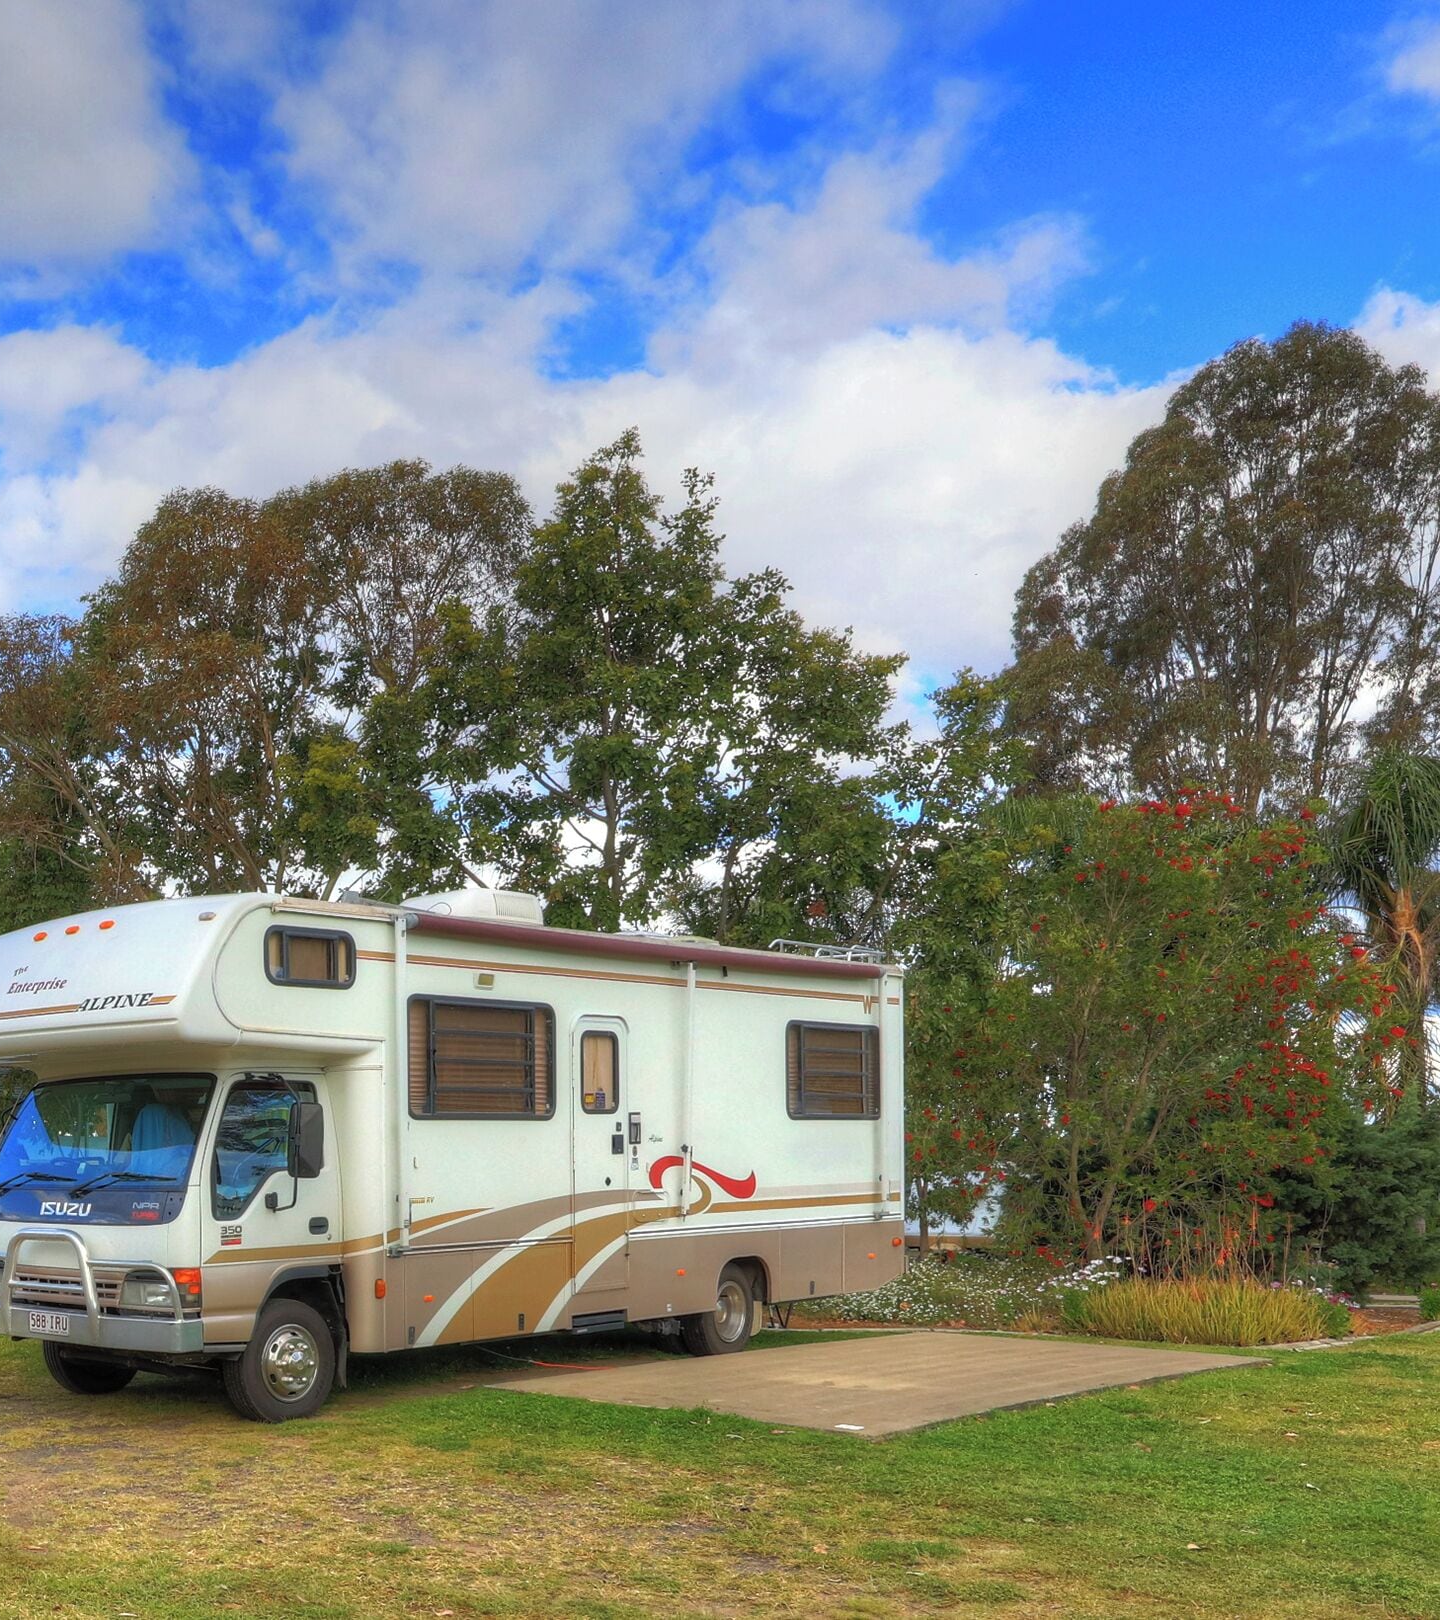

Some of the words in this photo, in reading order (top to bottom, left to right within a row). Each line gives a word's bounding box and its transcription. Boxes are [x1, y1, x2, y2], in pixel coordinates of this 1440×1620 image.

[14, 966, 28, 977] The
[7, 977, 67, 995] Enterprise
[75, 993, 154, 1013] ALPINE
[40, 1201, 92, 1217] ISUZU
[132, 1202, 160, 1210] NPR
[220, 1225, 243, 1235] 350
